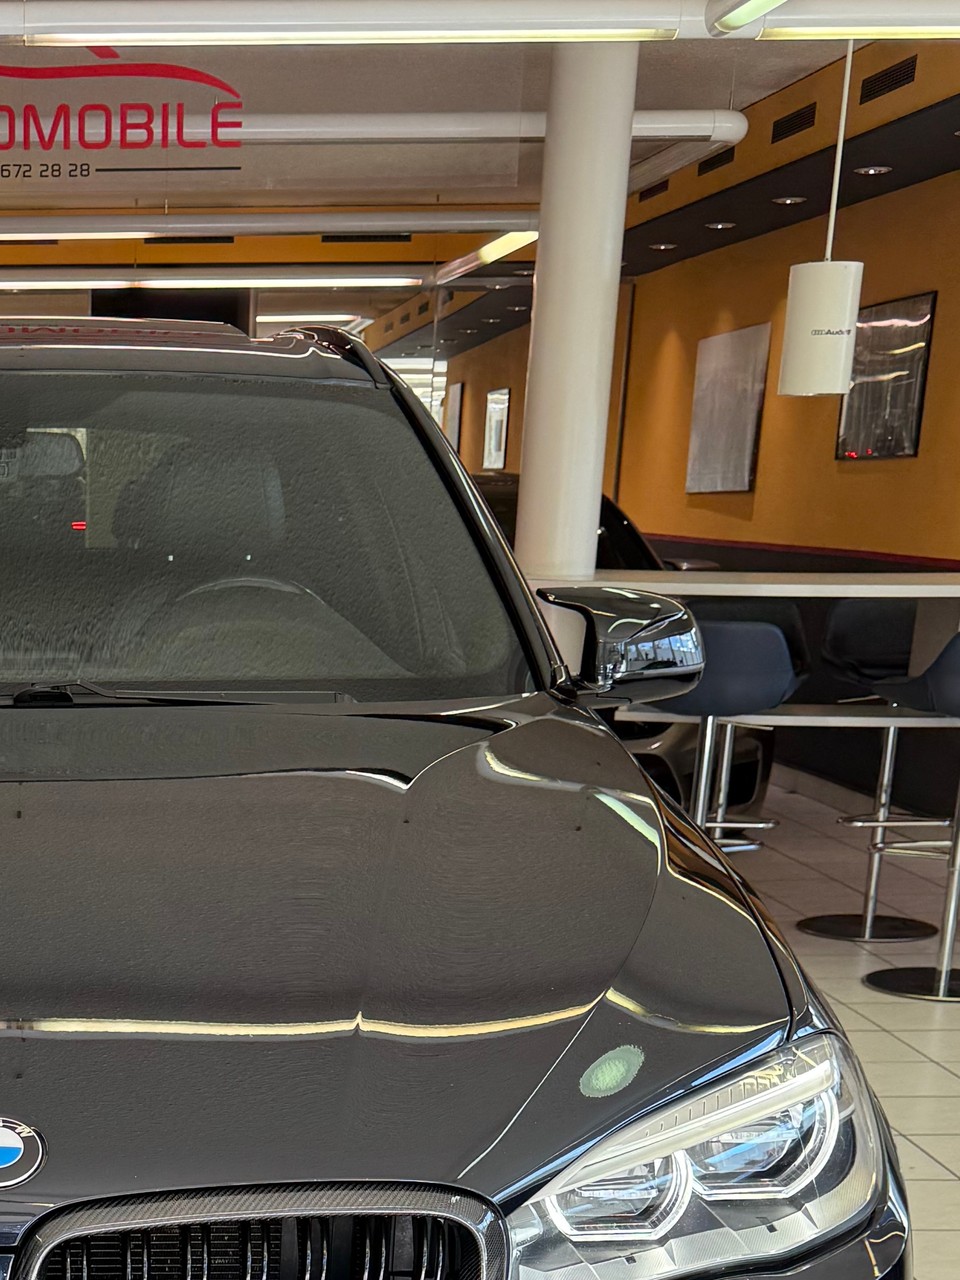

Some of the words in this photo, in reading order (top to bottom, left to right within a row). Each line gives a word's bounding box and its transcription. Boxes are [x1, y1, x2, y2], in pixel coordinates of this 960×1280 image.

[0, 164, 32, 178] 672
[39, 163, 61, 178] 28
[68, 163, 90, 178] 28
